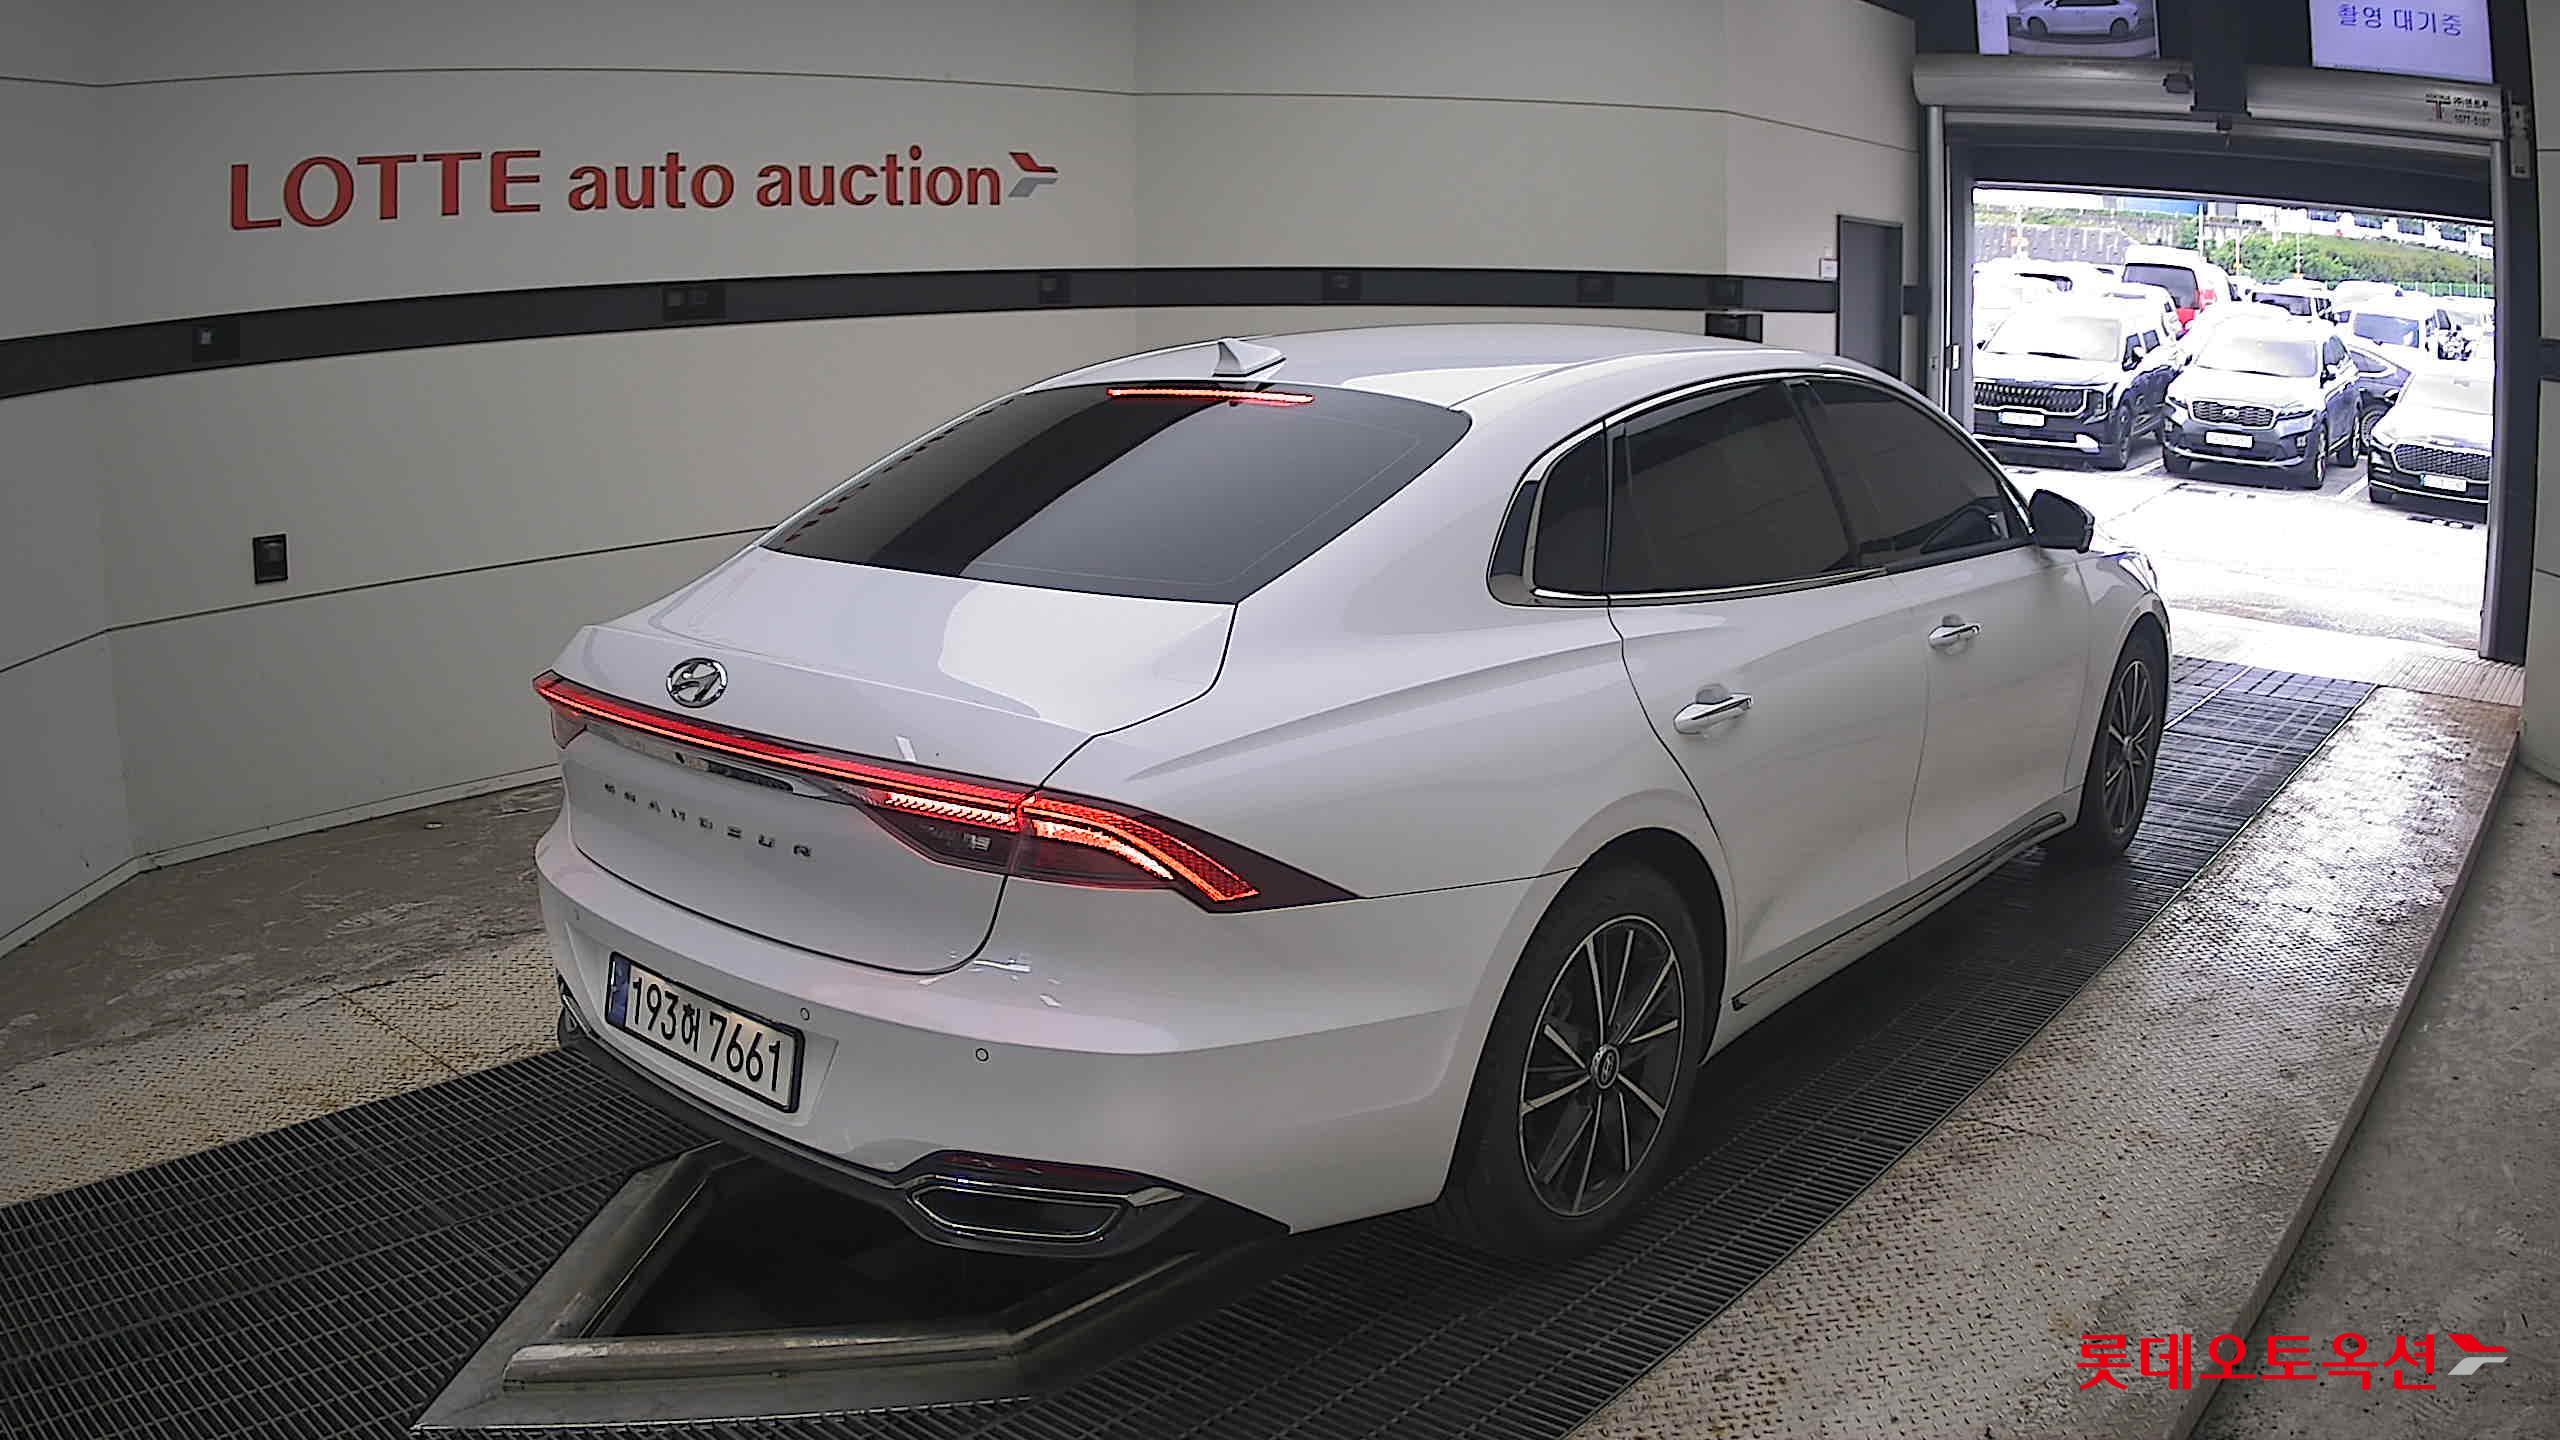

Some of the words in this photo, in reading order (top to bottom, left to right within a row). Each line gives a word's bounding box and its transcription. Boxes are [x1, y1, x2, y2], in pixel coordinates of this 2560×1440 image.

[2339, 3, 2382, 29] 촬영
[2393, 9, 2462, 37] 대기중
[230, 149, 541, 231] LOTTE
[567, 151, 735, 210] auto
[756, 145, 1001, 208] auction
